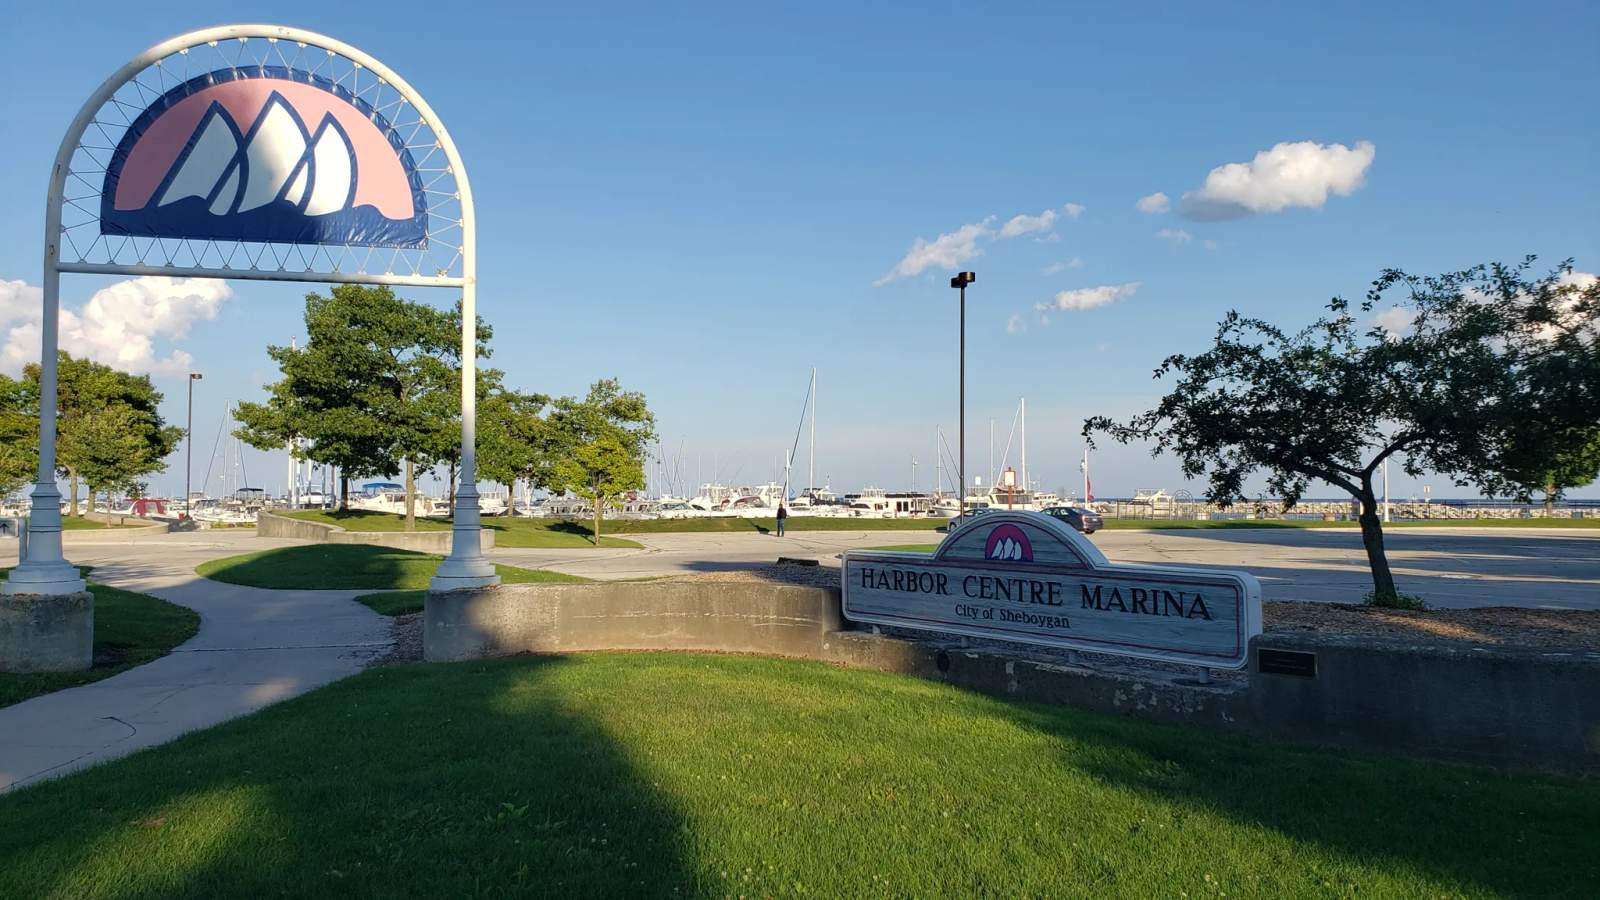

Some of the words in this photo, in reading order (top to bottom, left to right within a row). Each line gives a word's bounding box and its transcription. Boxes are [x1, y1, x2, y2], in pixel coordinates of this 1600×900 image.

[861, 567, 949, 595] HARBOR
[963, 575, 1063, 606] CENTRE
[1081, 584, 1211, 621] MARINA
[955, 604, 979, 620] City
[982, 608, 994, 620] of
[1000, 608, 1070, 628] Sheboygan
